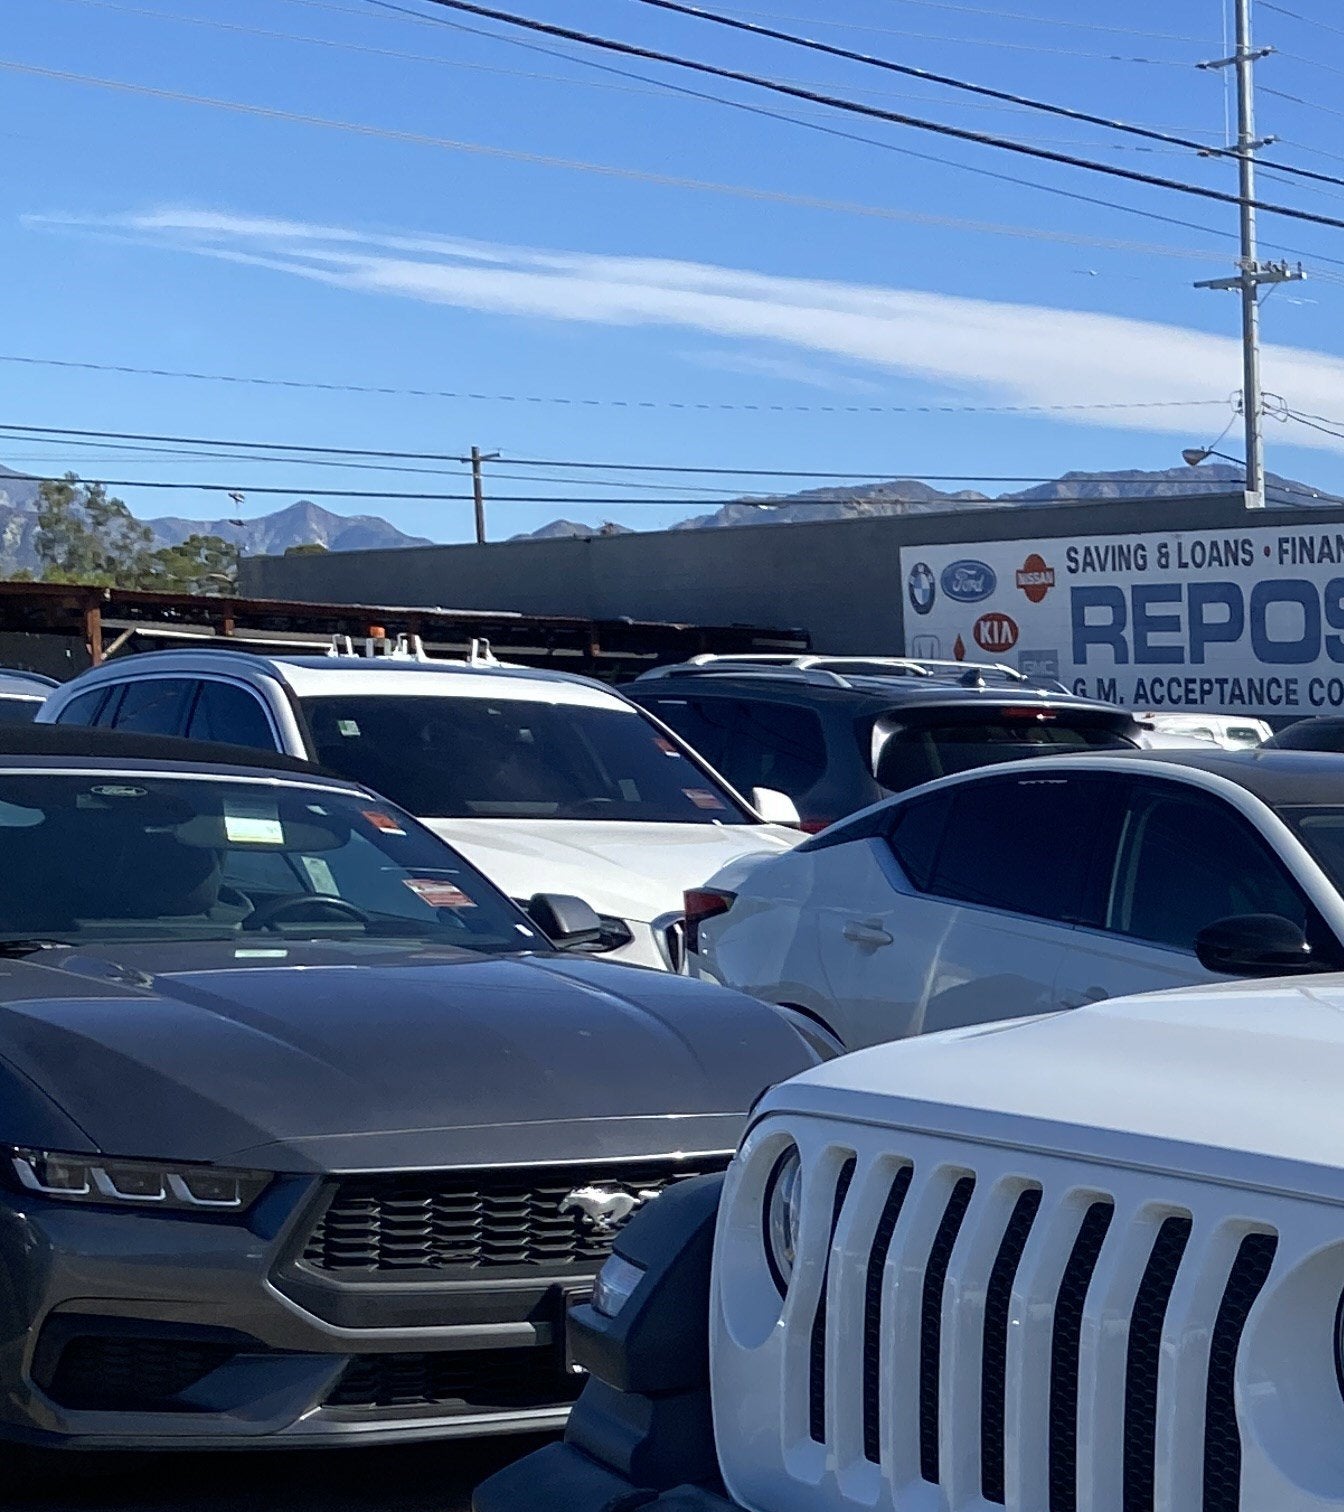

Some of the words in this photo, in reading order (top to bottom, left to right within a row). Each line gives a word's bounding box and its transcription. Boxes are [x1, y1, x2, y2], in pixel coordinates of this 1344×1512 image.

[1066, 543, 1147, 574] SAVING
[1156, 542, 1170, 570] &
[1177, 537, 1254, 569] LOANS
[979, 620, 1014, 645] KIA
[1133, 676, 1299, 706] ACCEPTANCE
